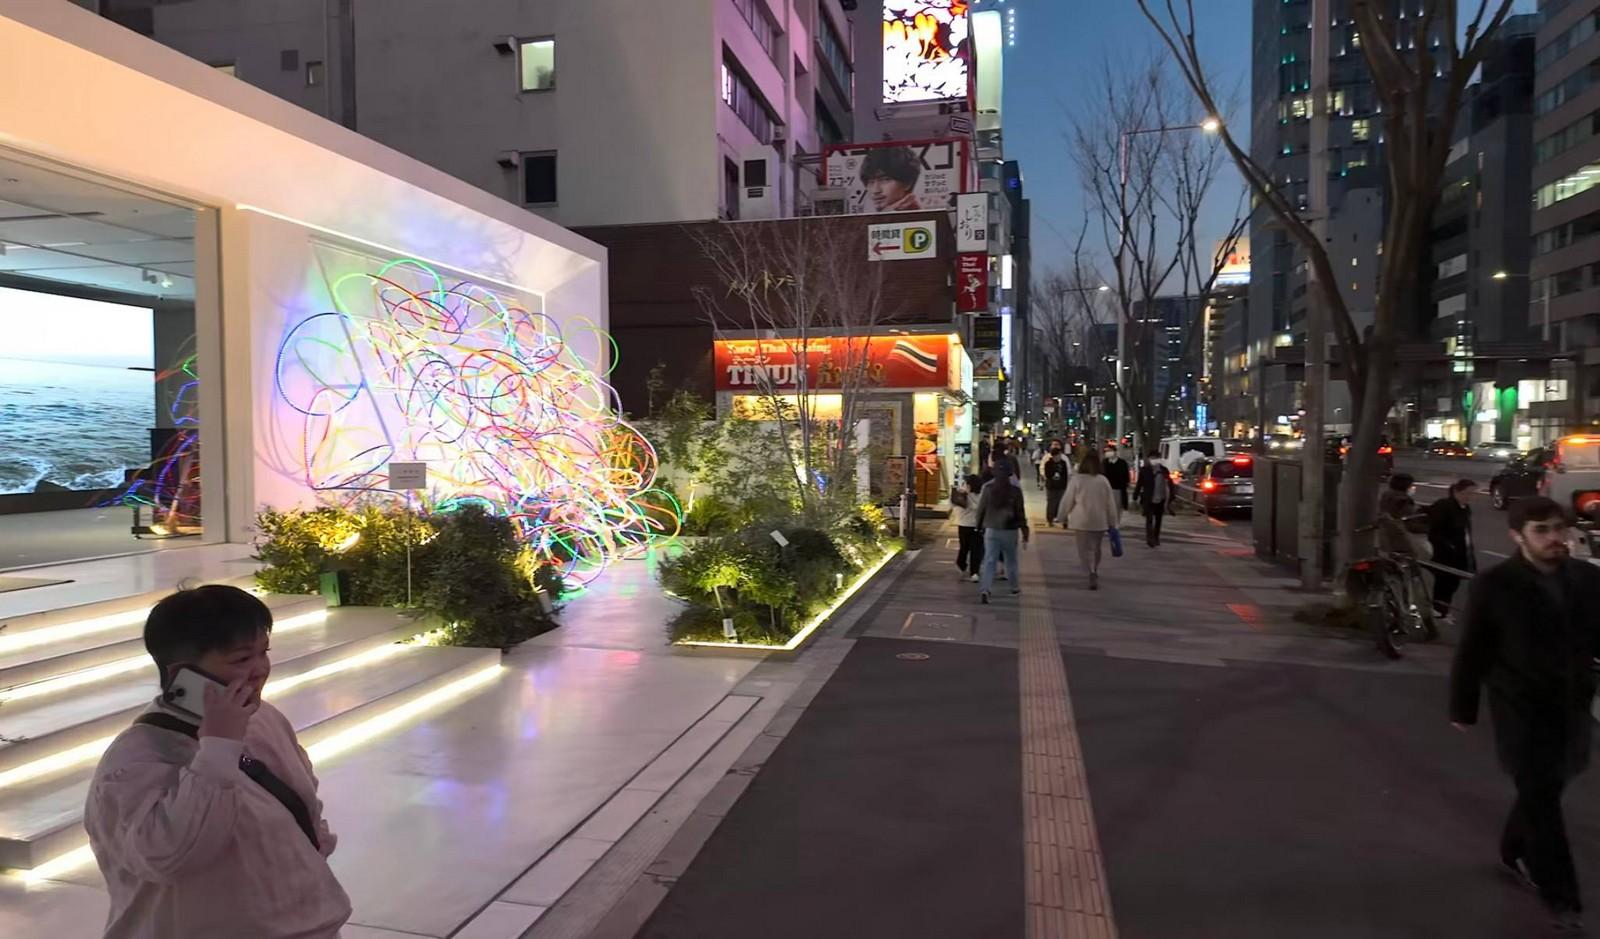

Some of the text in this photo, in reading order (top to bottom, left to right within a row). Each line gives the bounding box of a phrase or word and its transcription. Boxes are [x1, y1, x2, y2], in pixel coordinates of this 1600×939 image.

[871, 229, 901, 241] 時間貸
[760, 342, 787, 353] Thai
